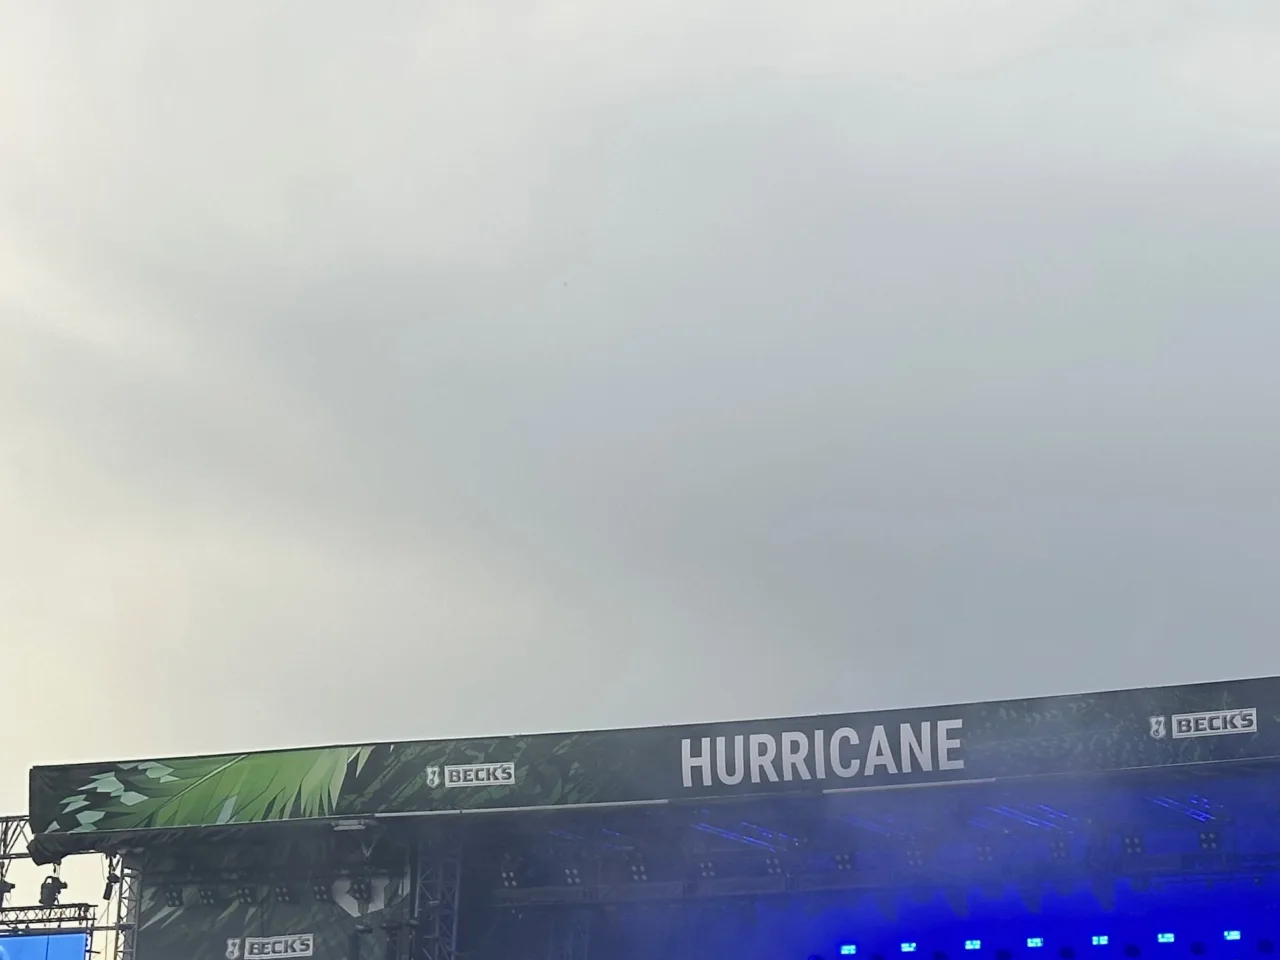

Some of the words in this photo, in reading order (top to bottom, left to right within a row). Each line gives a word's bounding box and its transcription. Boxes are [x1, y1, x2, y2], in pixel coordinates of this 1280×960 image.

[1176, 711, 1254, 734] BECK'S
[681, 719, 965, 788] HURRICANE
[447, 764, 513, 783] BECK'S
[248, 936, 311, 955] BECK'S
